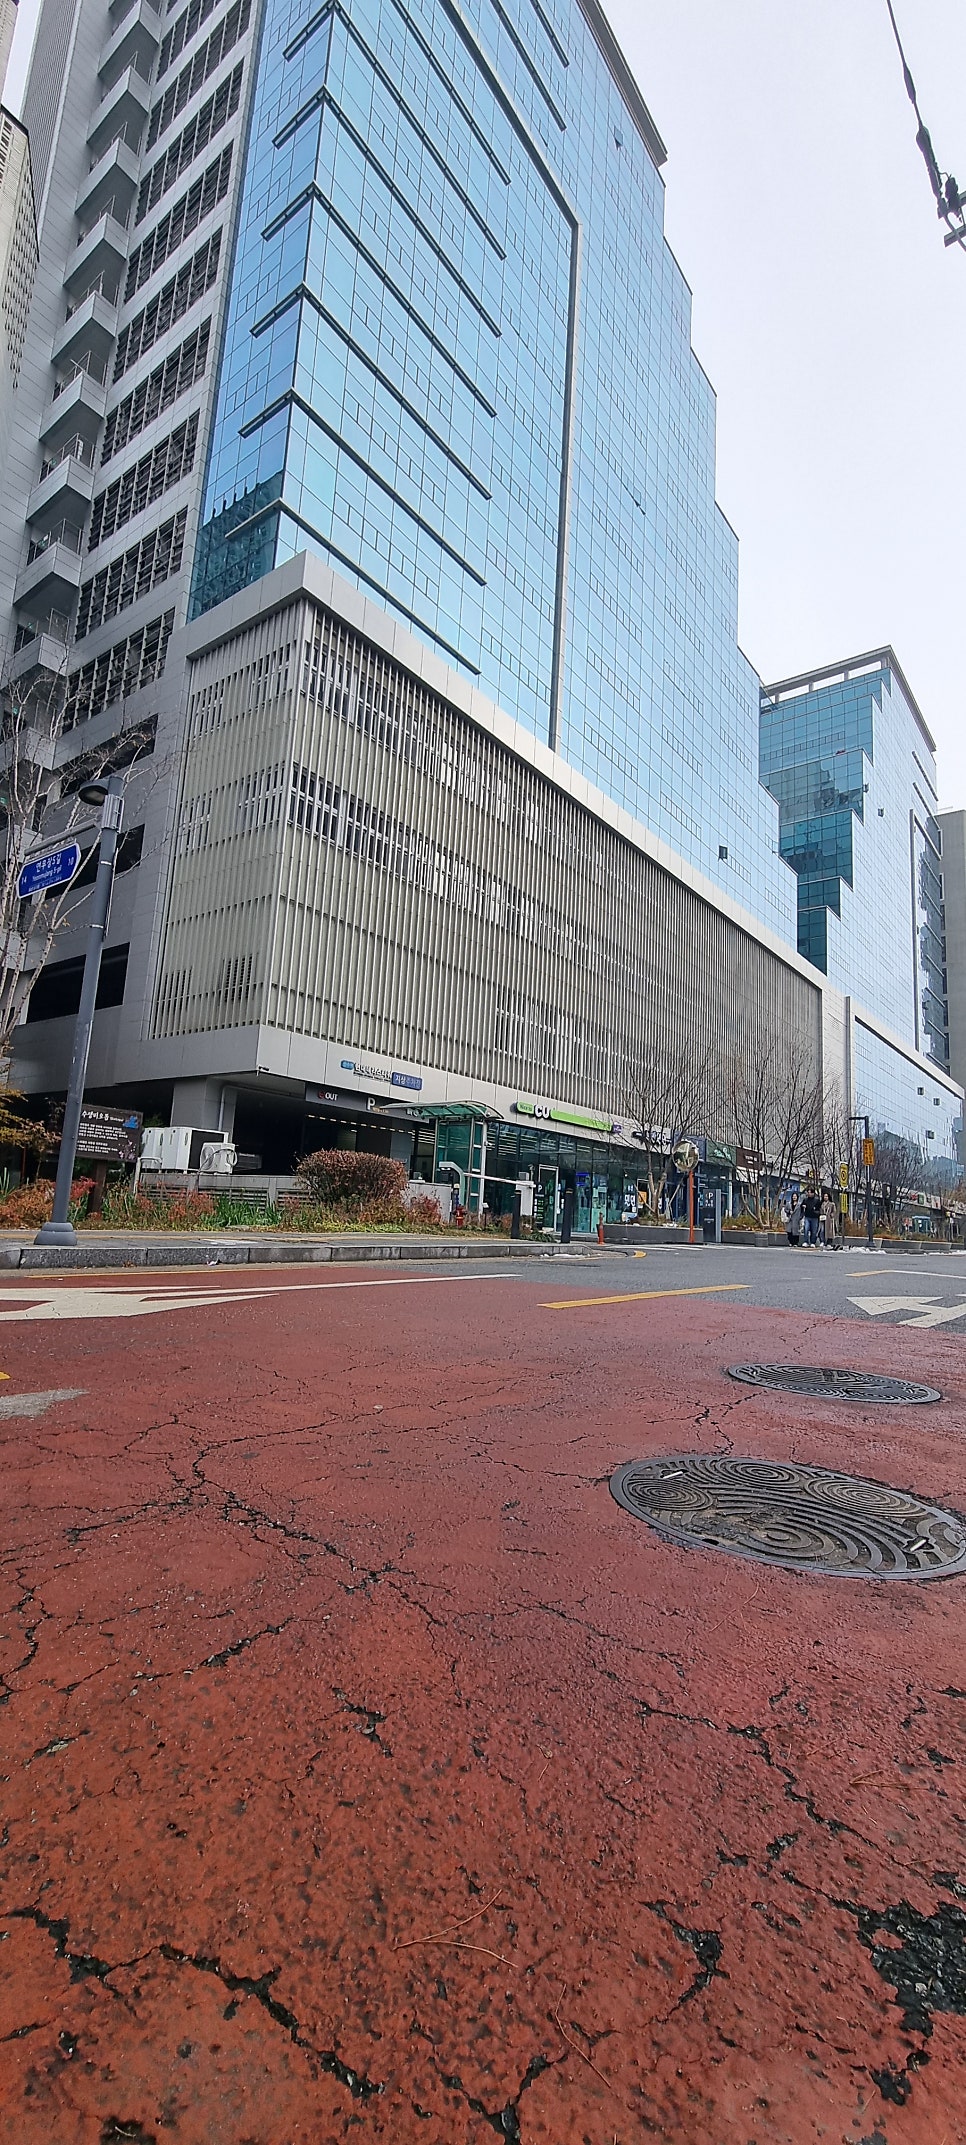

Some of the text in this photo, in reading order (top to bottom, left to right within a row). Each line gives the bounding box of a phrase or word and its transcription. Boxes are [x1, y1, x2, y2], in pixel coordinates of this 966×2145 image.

[36, 853, 62, 873] 연무장5길
[325, 1092, 338, 1101] OUT
[367, 1097, 376, 1110] P
[534, 1105, 550, 1119] CU
[708, 1192, 714, 1200] P
